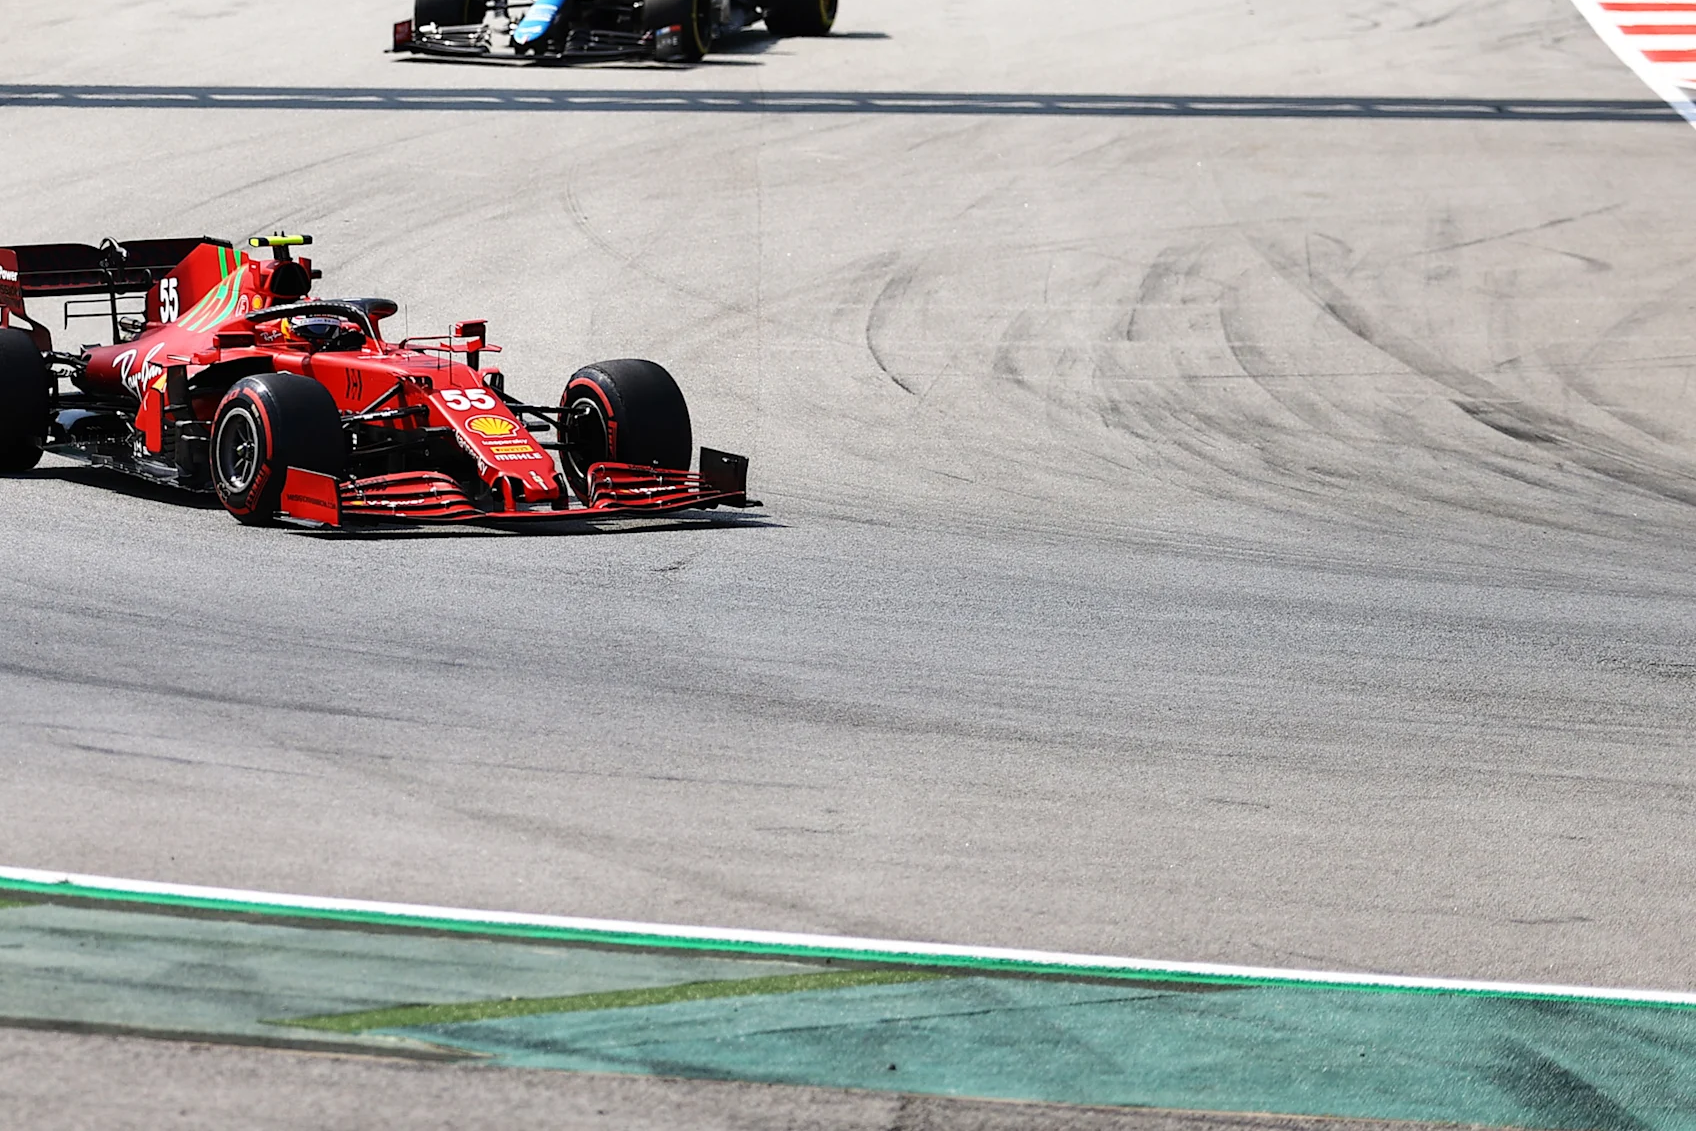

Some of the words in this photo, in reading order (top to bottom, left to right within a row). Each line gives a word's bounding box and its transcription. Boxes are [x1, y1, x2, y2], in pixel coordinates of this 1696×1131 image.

[159, 277, 180, 324] 55
[440, 388, 496, 411] 55
[494, 452, 543, 461] MAHLE
